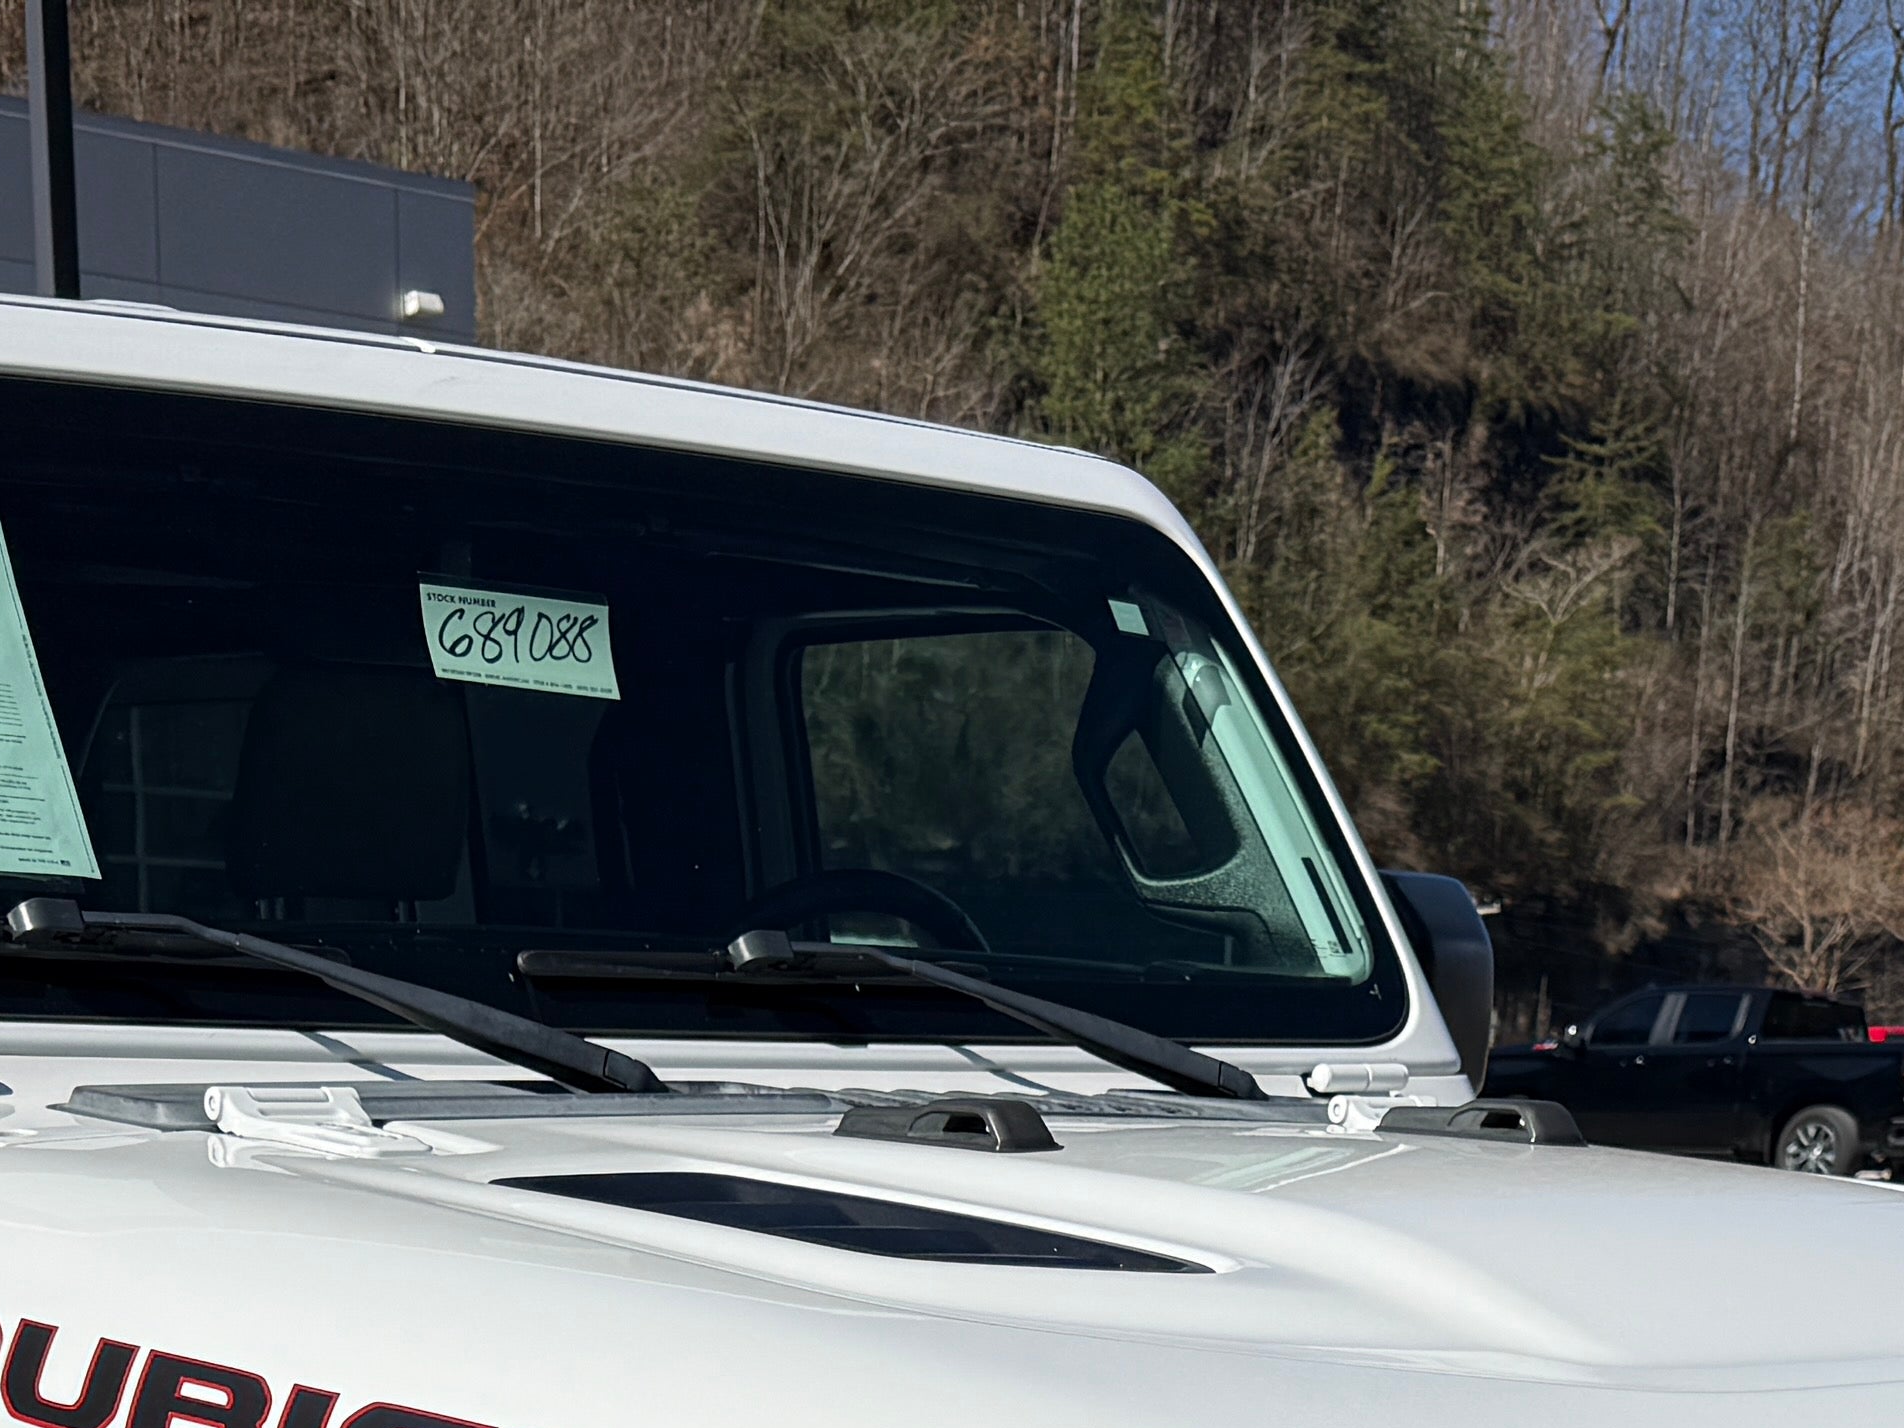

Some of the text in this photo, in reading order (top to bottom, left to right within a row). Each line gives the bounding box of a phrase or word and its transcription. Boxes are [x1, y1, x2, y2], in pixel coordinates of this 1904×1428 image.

[426, 592, 497, 608] STOCK NUMBER
[438, 605, 599, 664] 689088
